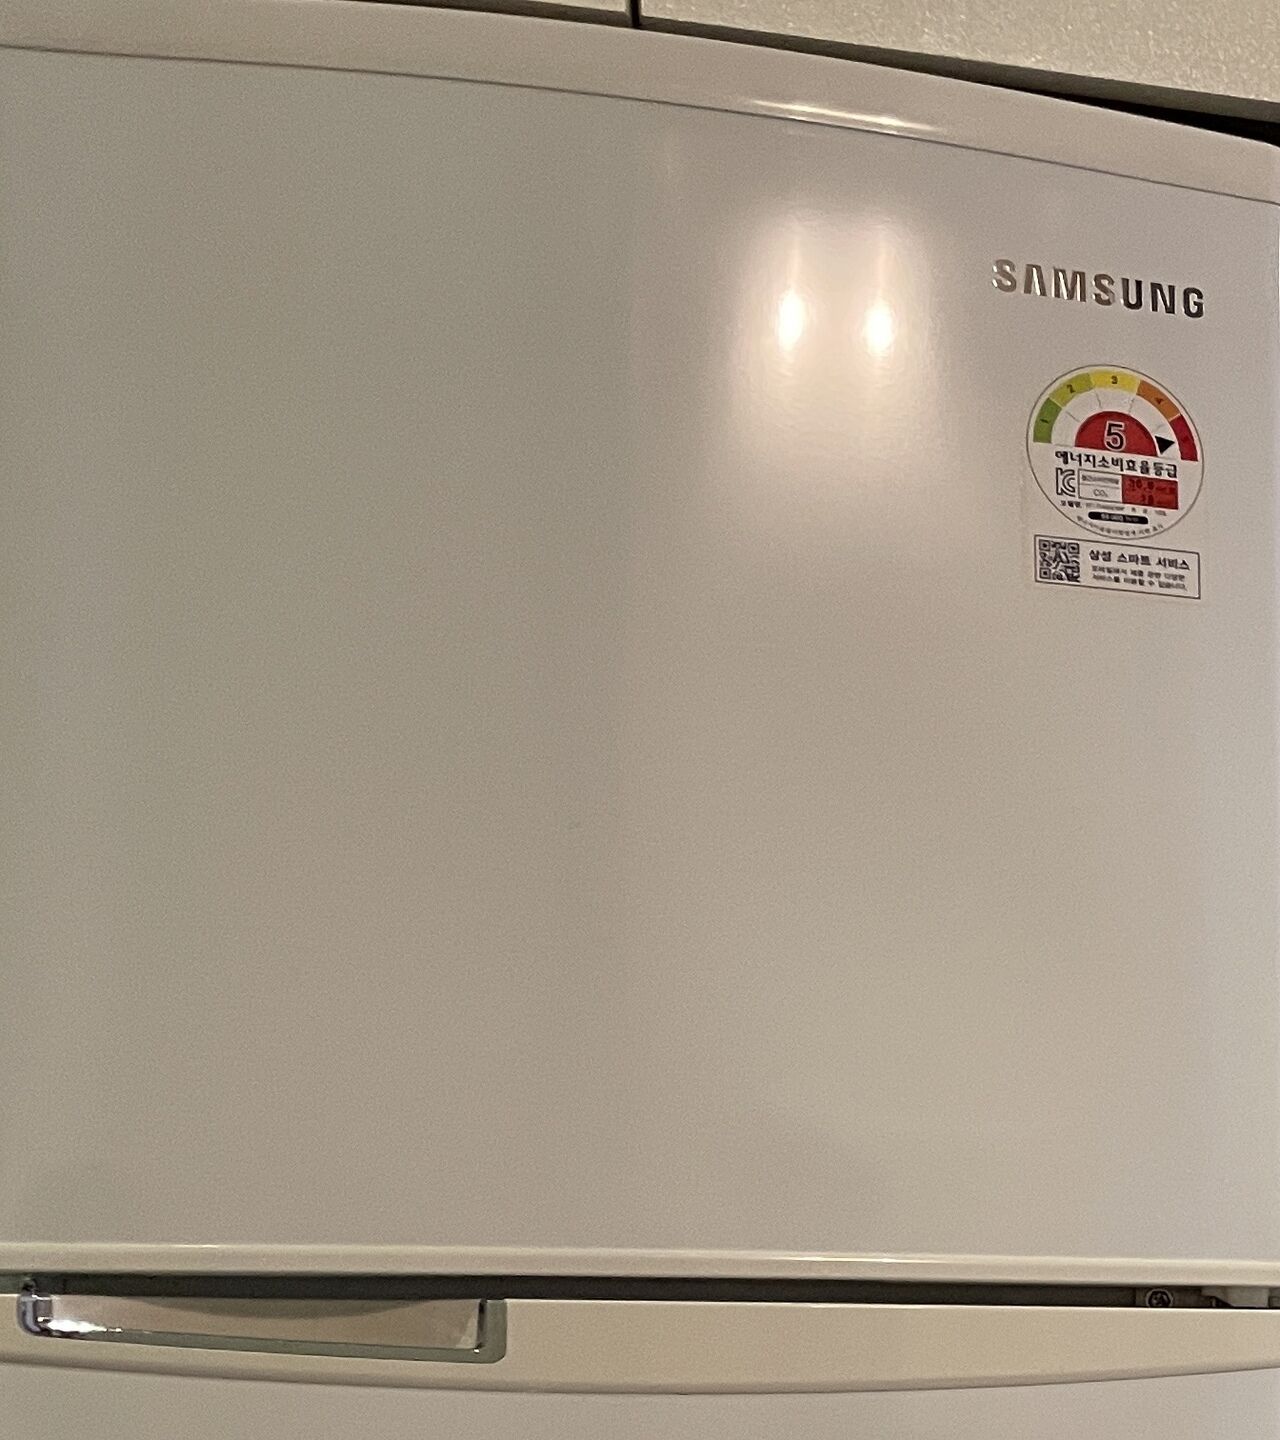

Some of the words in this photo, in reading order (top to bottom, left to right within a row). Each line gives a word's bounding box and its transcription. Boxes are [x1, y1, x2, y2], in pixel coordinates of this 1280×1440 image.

[992, 259, 1205, 319] SAMSUNG
[1106, 422, 1125, 451] 5
[1054, 450, 1178, 479] 에너지소비효율등급
[1154, 556, 1191, 571] 서비스
